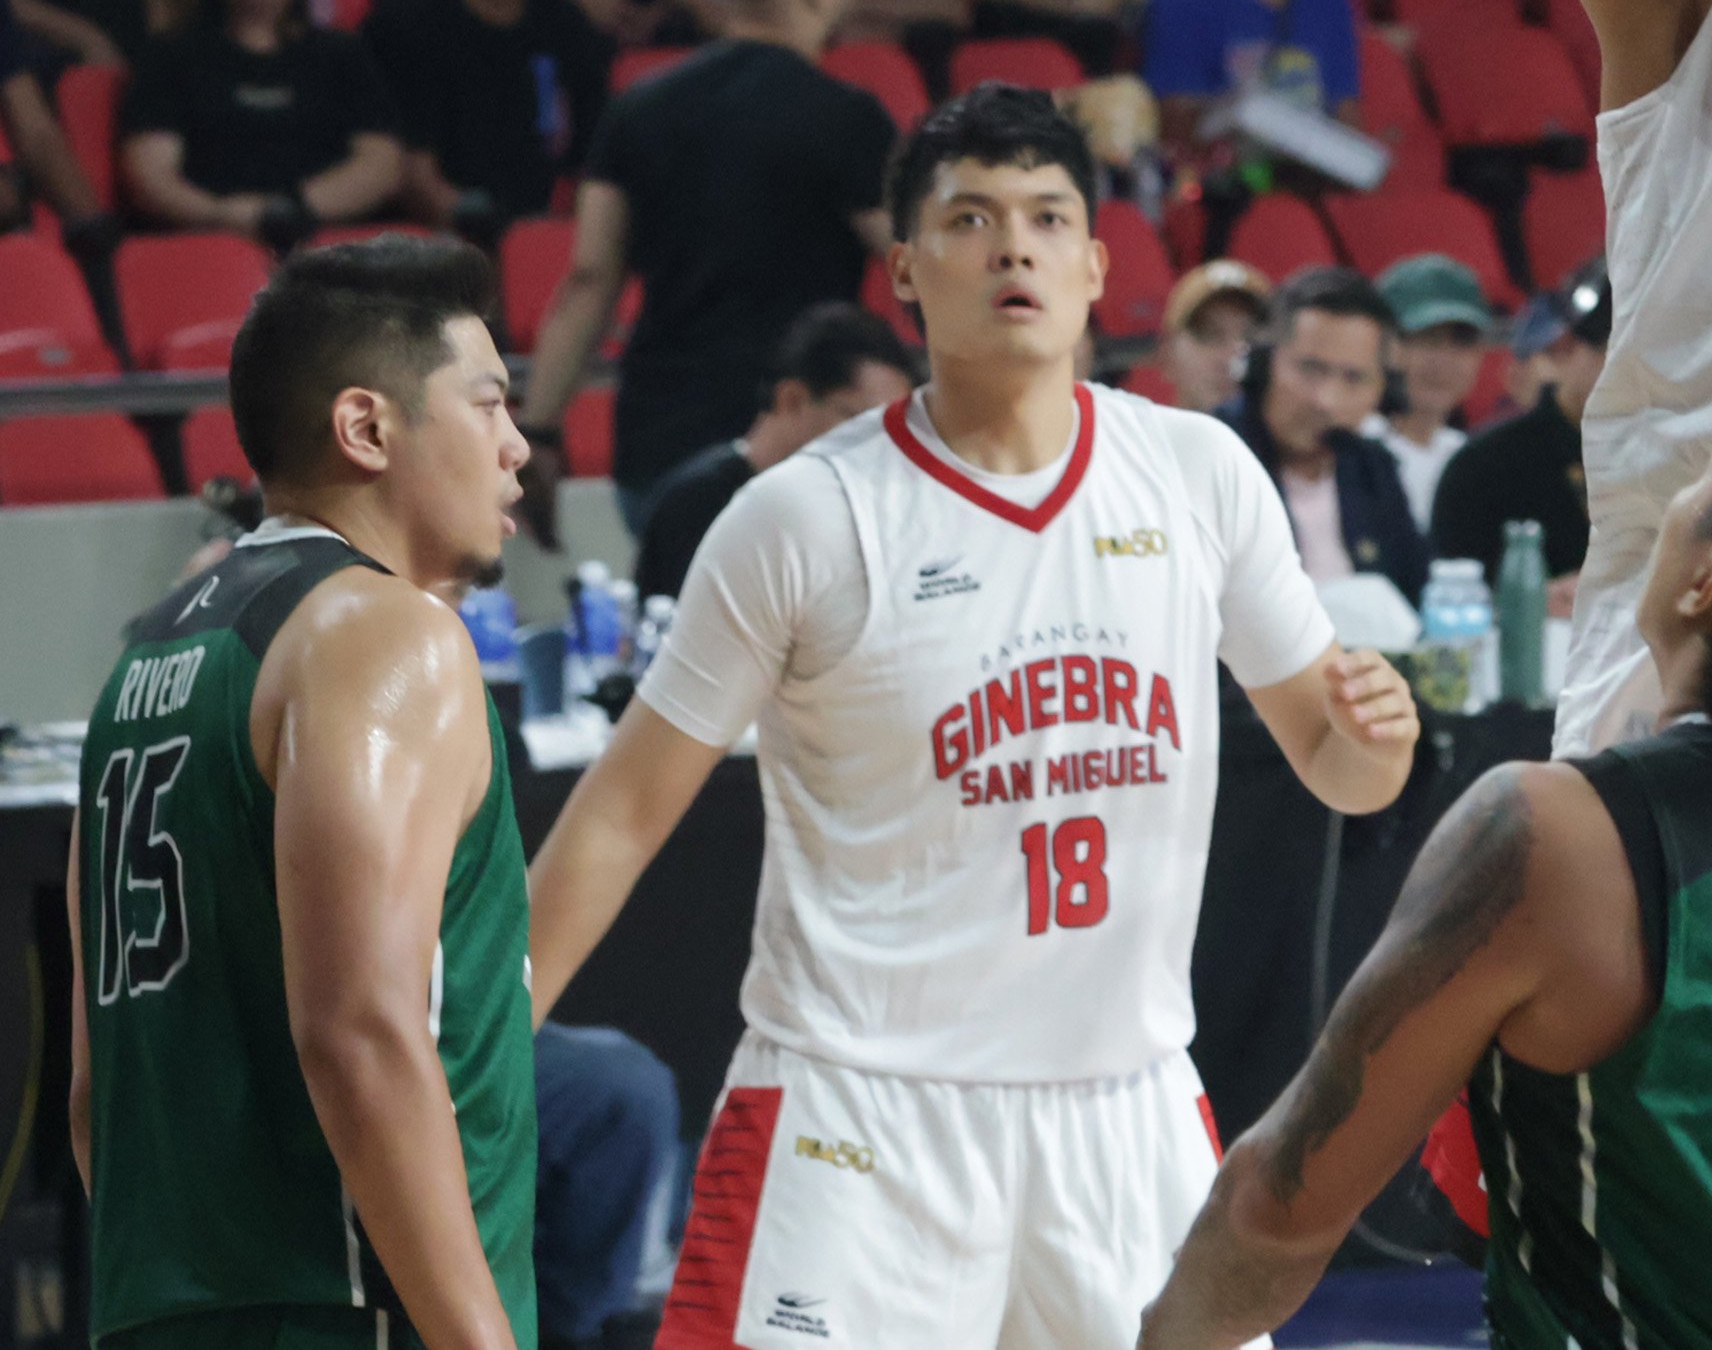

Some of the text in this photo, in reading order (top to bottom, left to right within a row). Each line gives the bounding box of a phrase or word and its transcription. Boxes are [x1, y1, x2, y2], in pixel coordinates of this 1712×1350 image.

[114, 644, 206, 723] RIVERO
[931, 654, 1182, 781] GINEBRA
[960, 744, 1168, 808] SAN MIGUEL
[96, 734, 191, 1006] 15
[1021, 815, 1110, 937] 18
